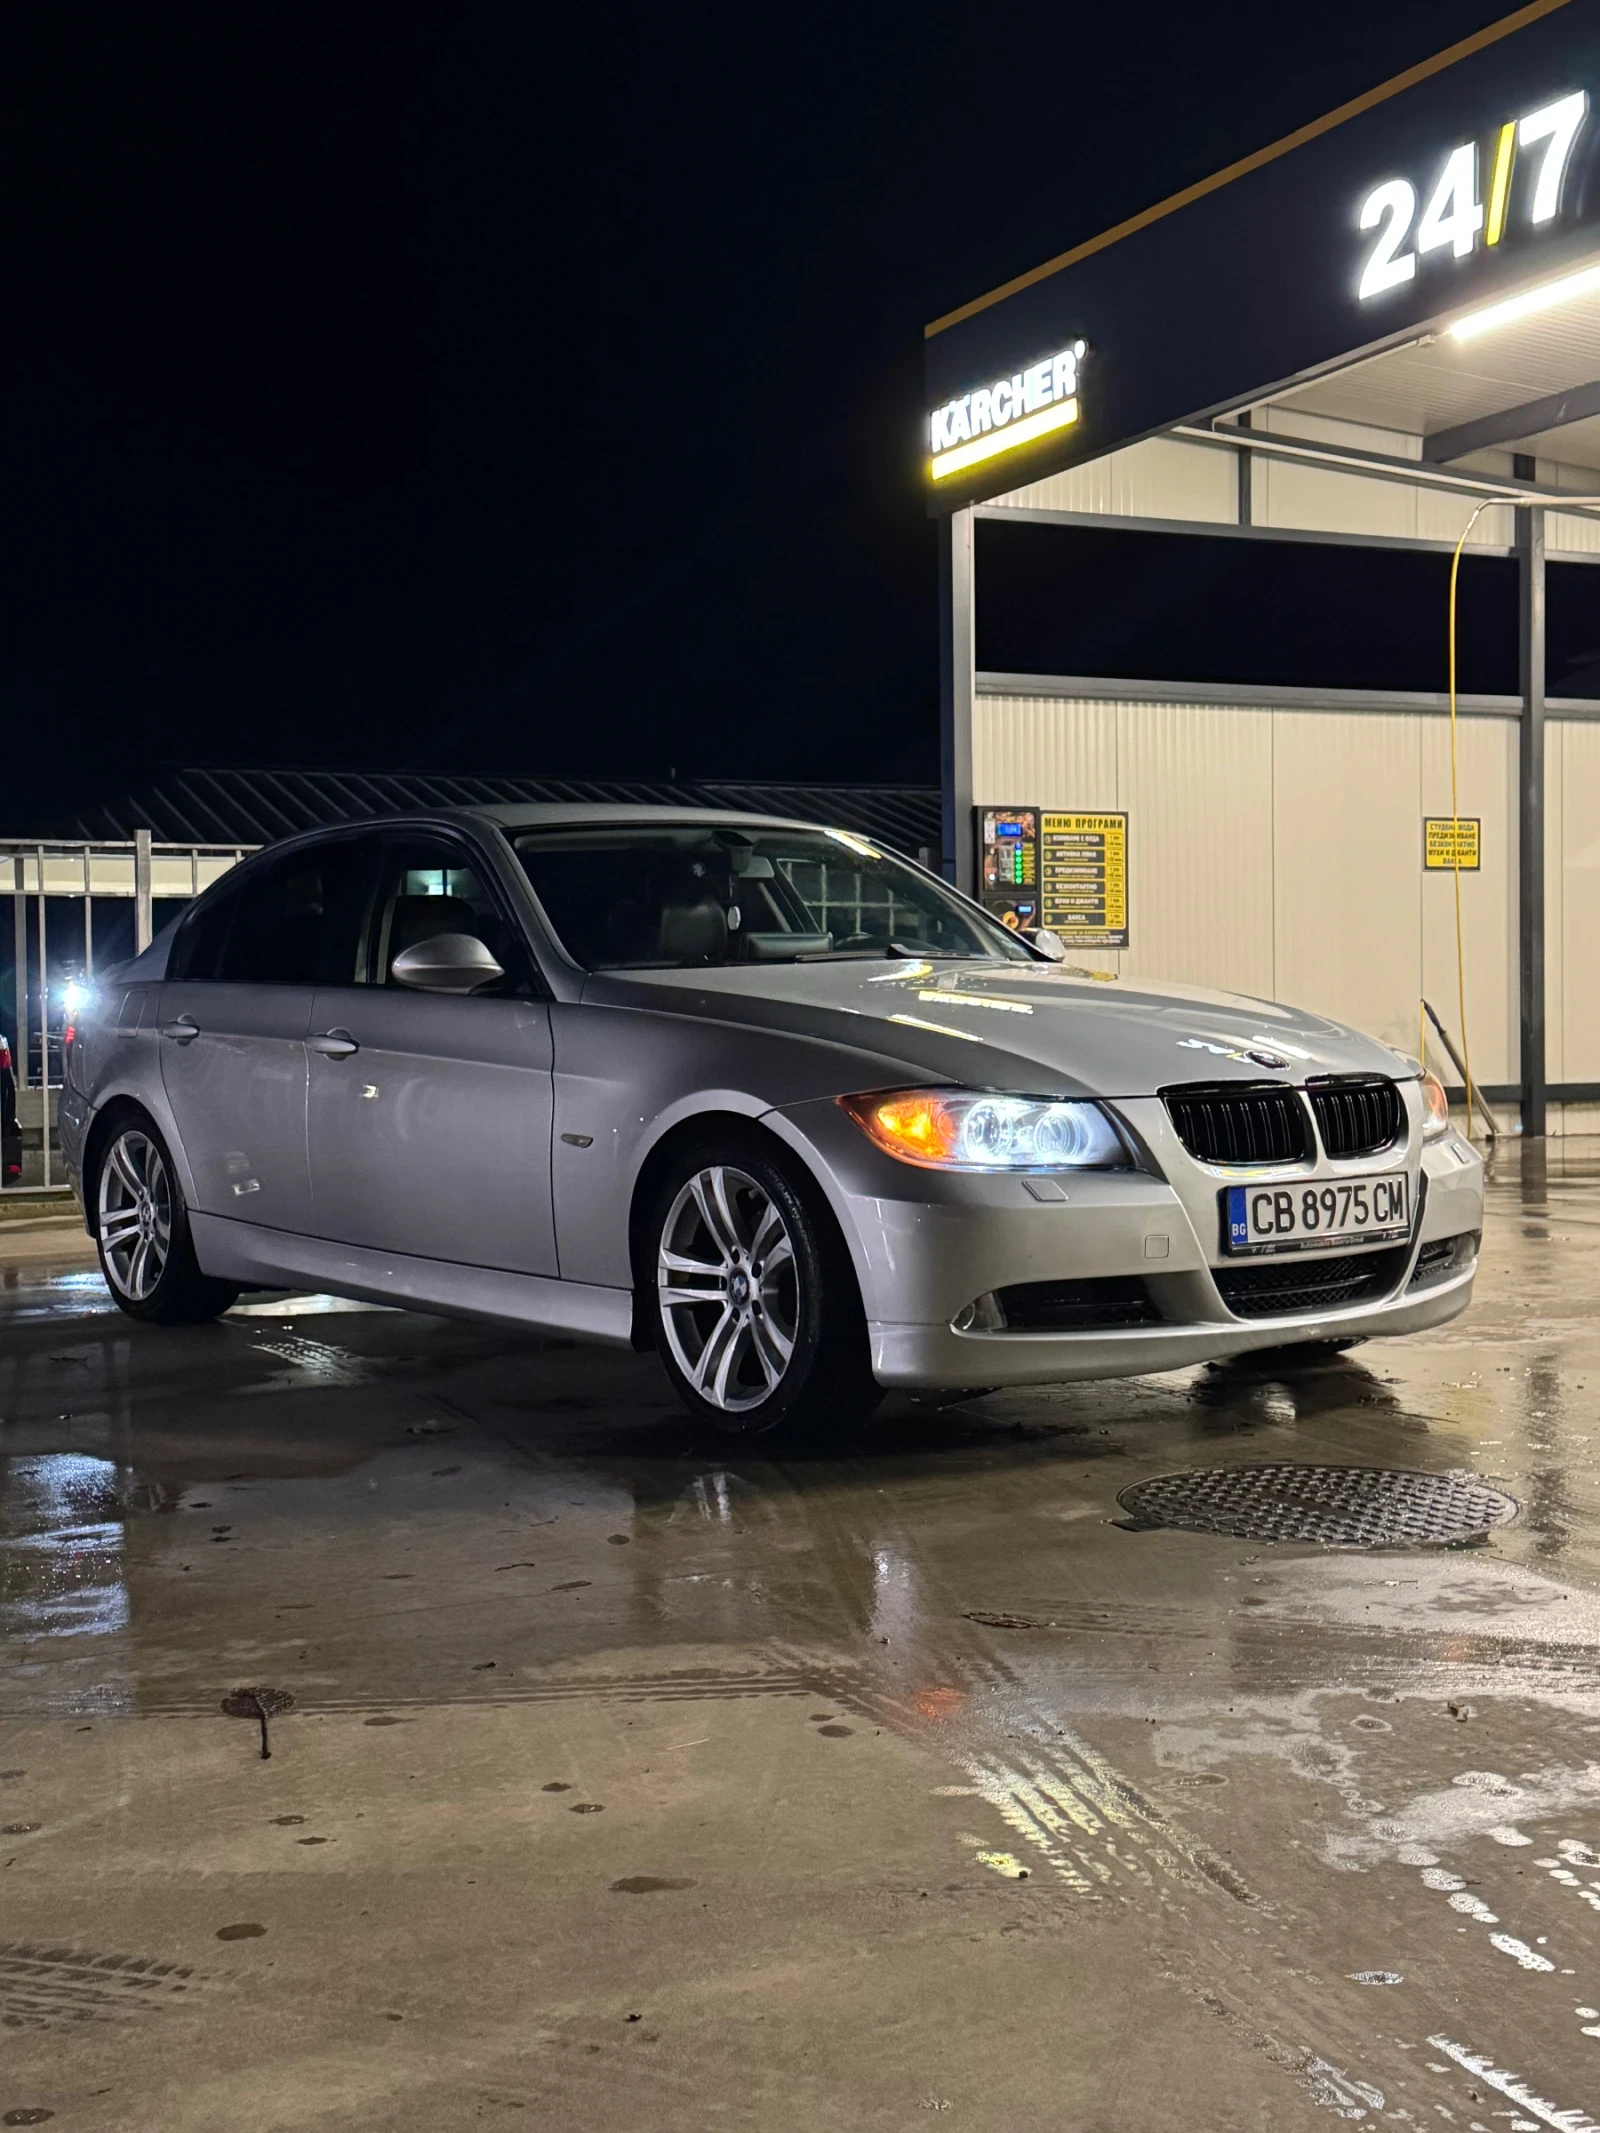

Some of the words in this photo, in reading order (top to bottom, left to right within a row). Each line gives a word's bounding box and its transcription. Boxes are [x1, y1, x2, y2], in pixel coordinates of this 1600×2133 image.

[1359, 90, 1587, 300] 24/7
[1044, 817, 1072, 828] МЕНЮ
[1075, 818, 1124, 829] ПРОГРАМИ
[1252, 1191, 1296, 1235] CB
[1301, 1184, 1369, 1231] 8975
[1373, 1178, 1404, 1223] CM
[1231, 1222, 1246, 1236] BG
